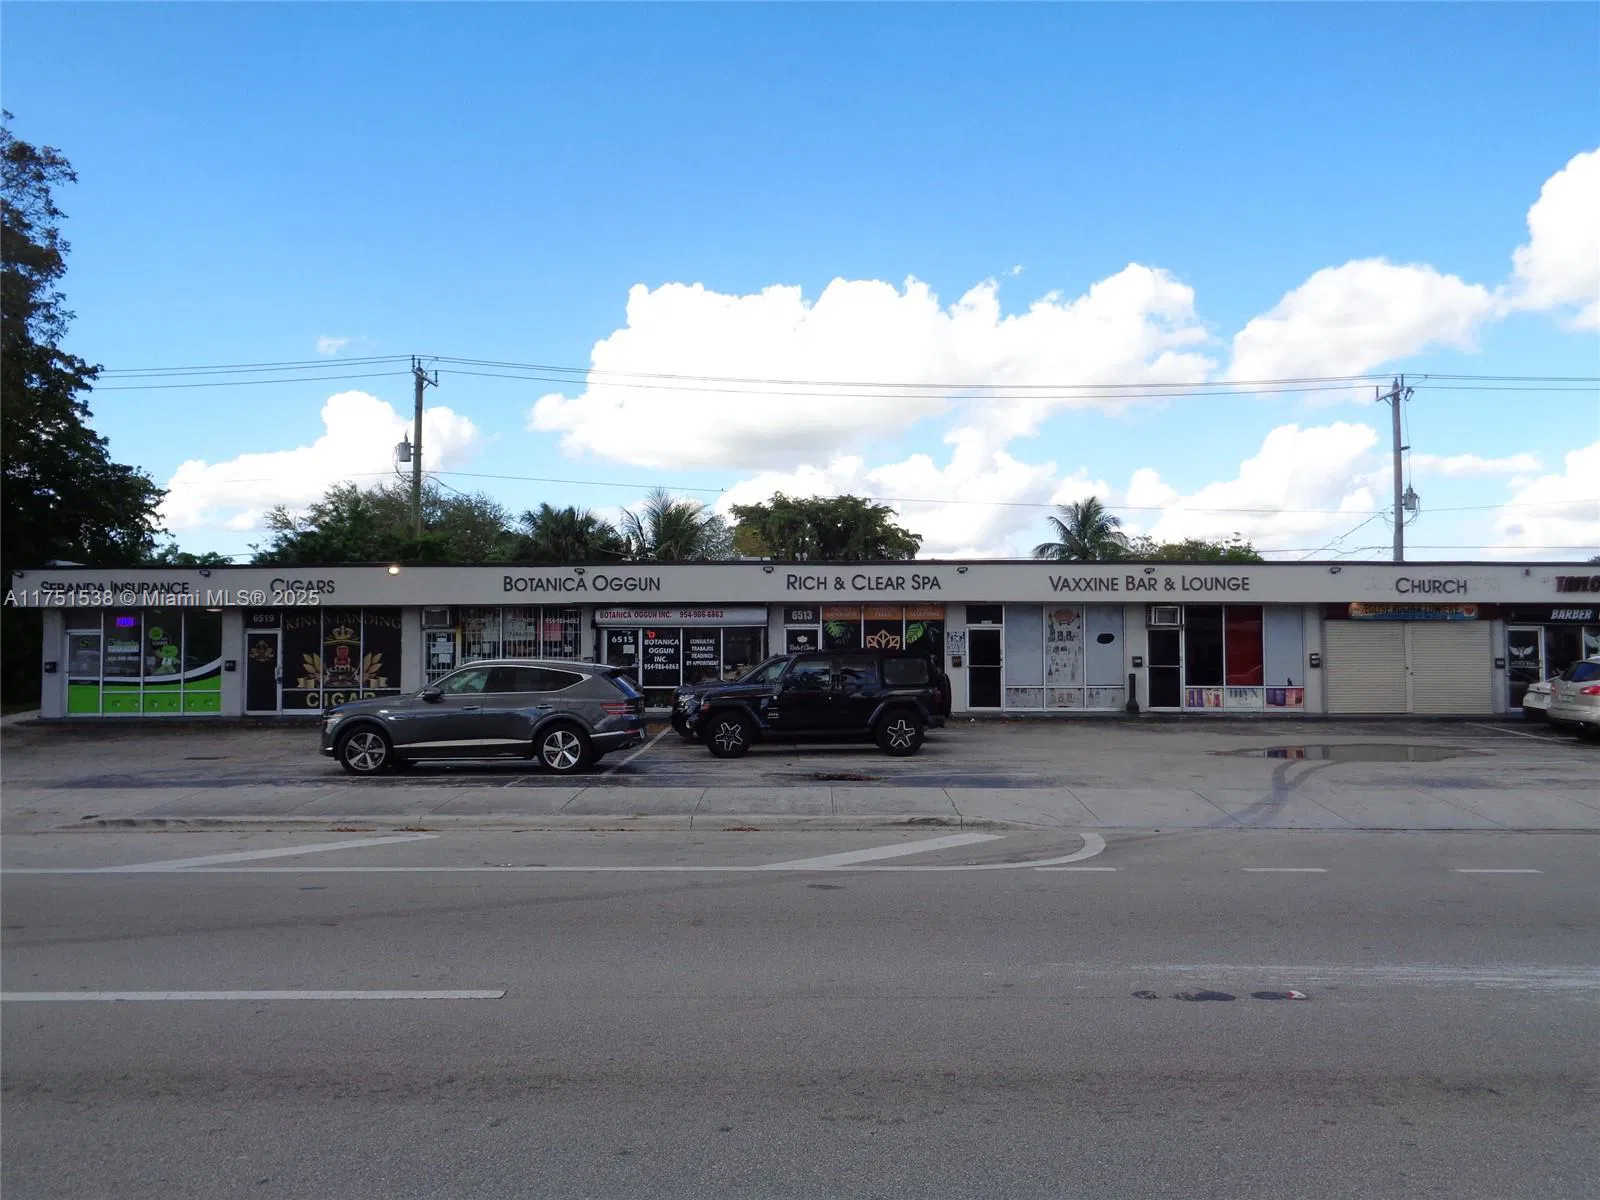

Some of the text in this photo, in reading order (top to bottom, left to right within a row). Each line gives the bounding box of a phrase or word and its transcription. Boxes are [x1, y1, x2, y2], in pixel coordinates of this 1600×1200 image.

[110, 580, 190, 595] INSURANCE
[270, 578, 335, 594] CIGARS
[503, 574, 661, 592] BOTANICA OGGUN
[786, 574, 942, 591] RICH & CLEAR SPA
[1048, 575, 1250, 592] VAXXINE BAR & LOUNGE
[1395, 577, 1468, 595] CHURCH
[600, 611, 632, 619] BOTANICA
[634, 611, 658, 619] OGGUN
[791, 610, 813, 620] 6513
[1551, 608, 1592, 620] BARBER
[644, 638, 680, 646] BOTANICA
